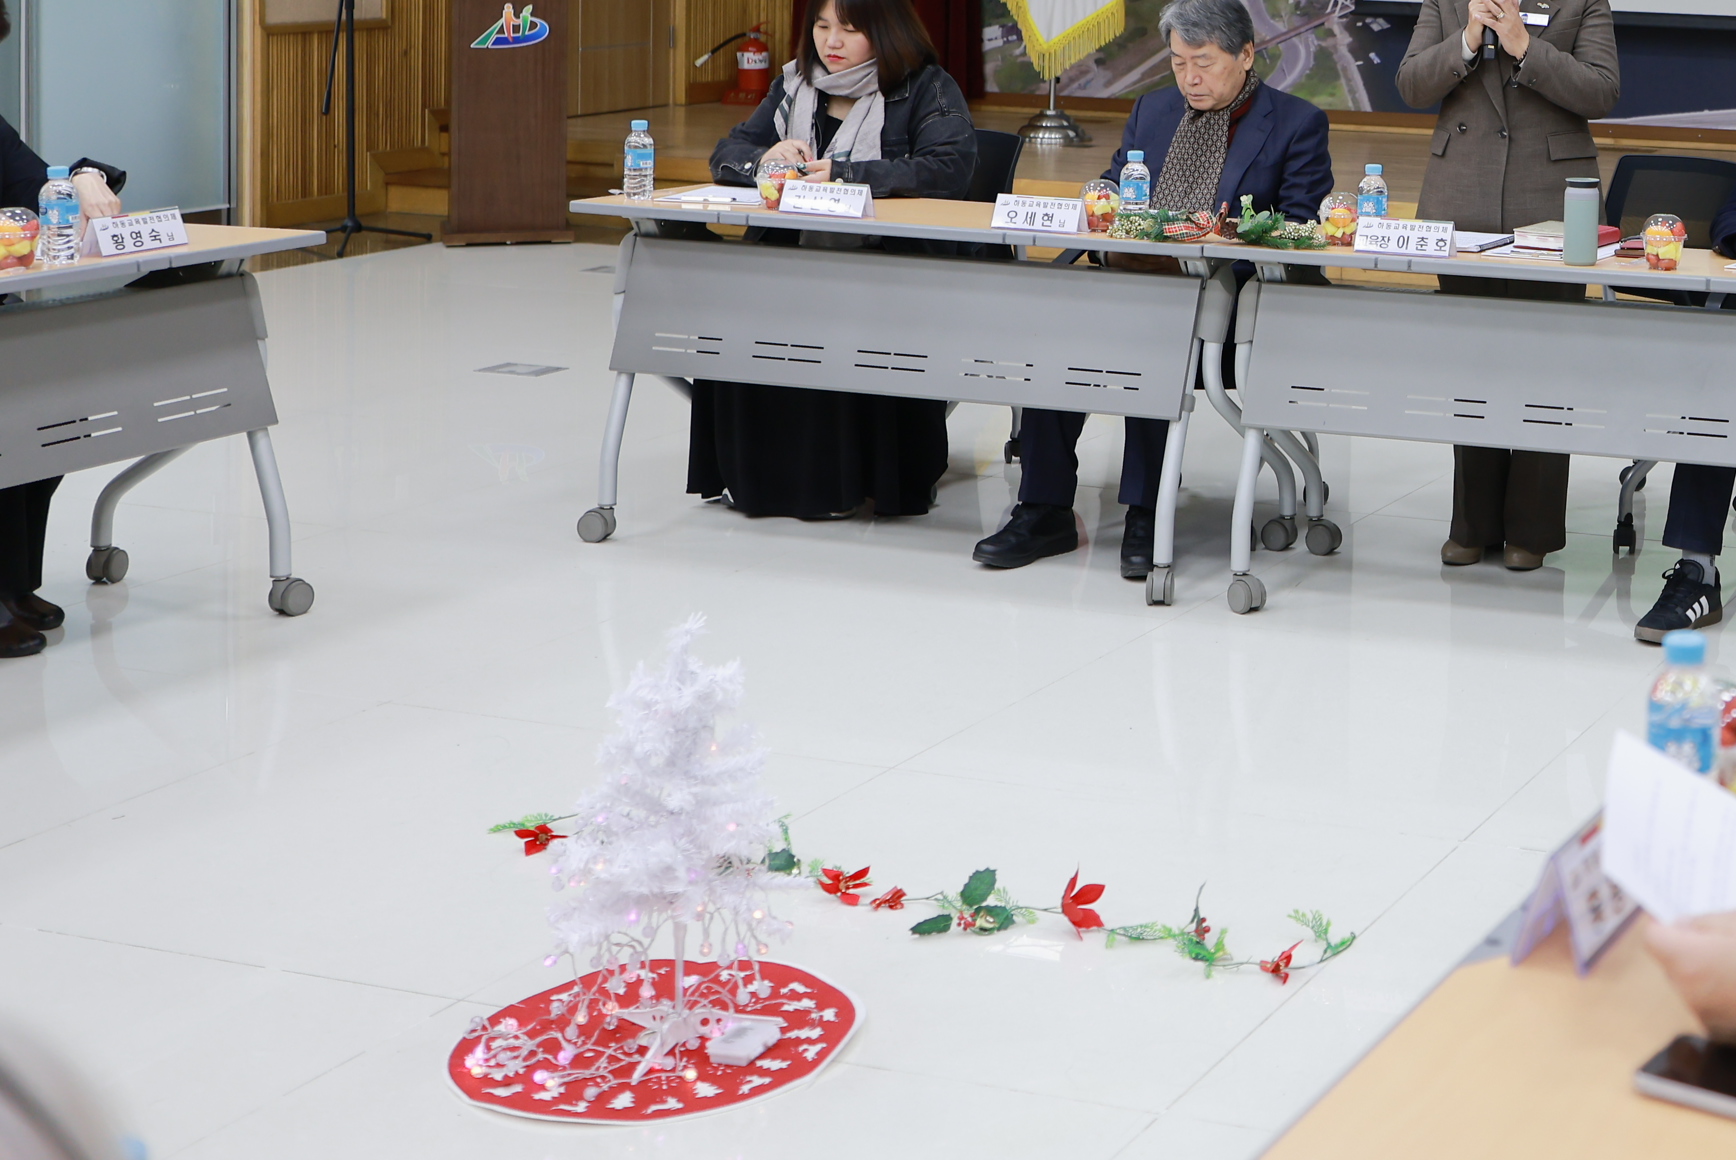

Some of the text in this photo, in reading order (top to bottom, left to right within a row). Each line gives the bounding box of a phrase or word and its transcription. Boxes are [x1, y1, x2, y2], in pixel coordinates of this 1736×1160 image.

[801, 184, 864, 196] 하동교육발전협의체
[1013, 199, 1078, 211] 하동교육발전협의체
[112, 213, 178, 229] 하동교육발전협의체
[1058, 219, 1066, 228] 님
[1377, 222, 1449, 234] 하동교육발전협의체
[166, 231, 175, 242] 님
[1358, 234, 1391, 249] 교육장
